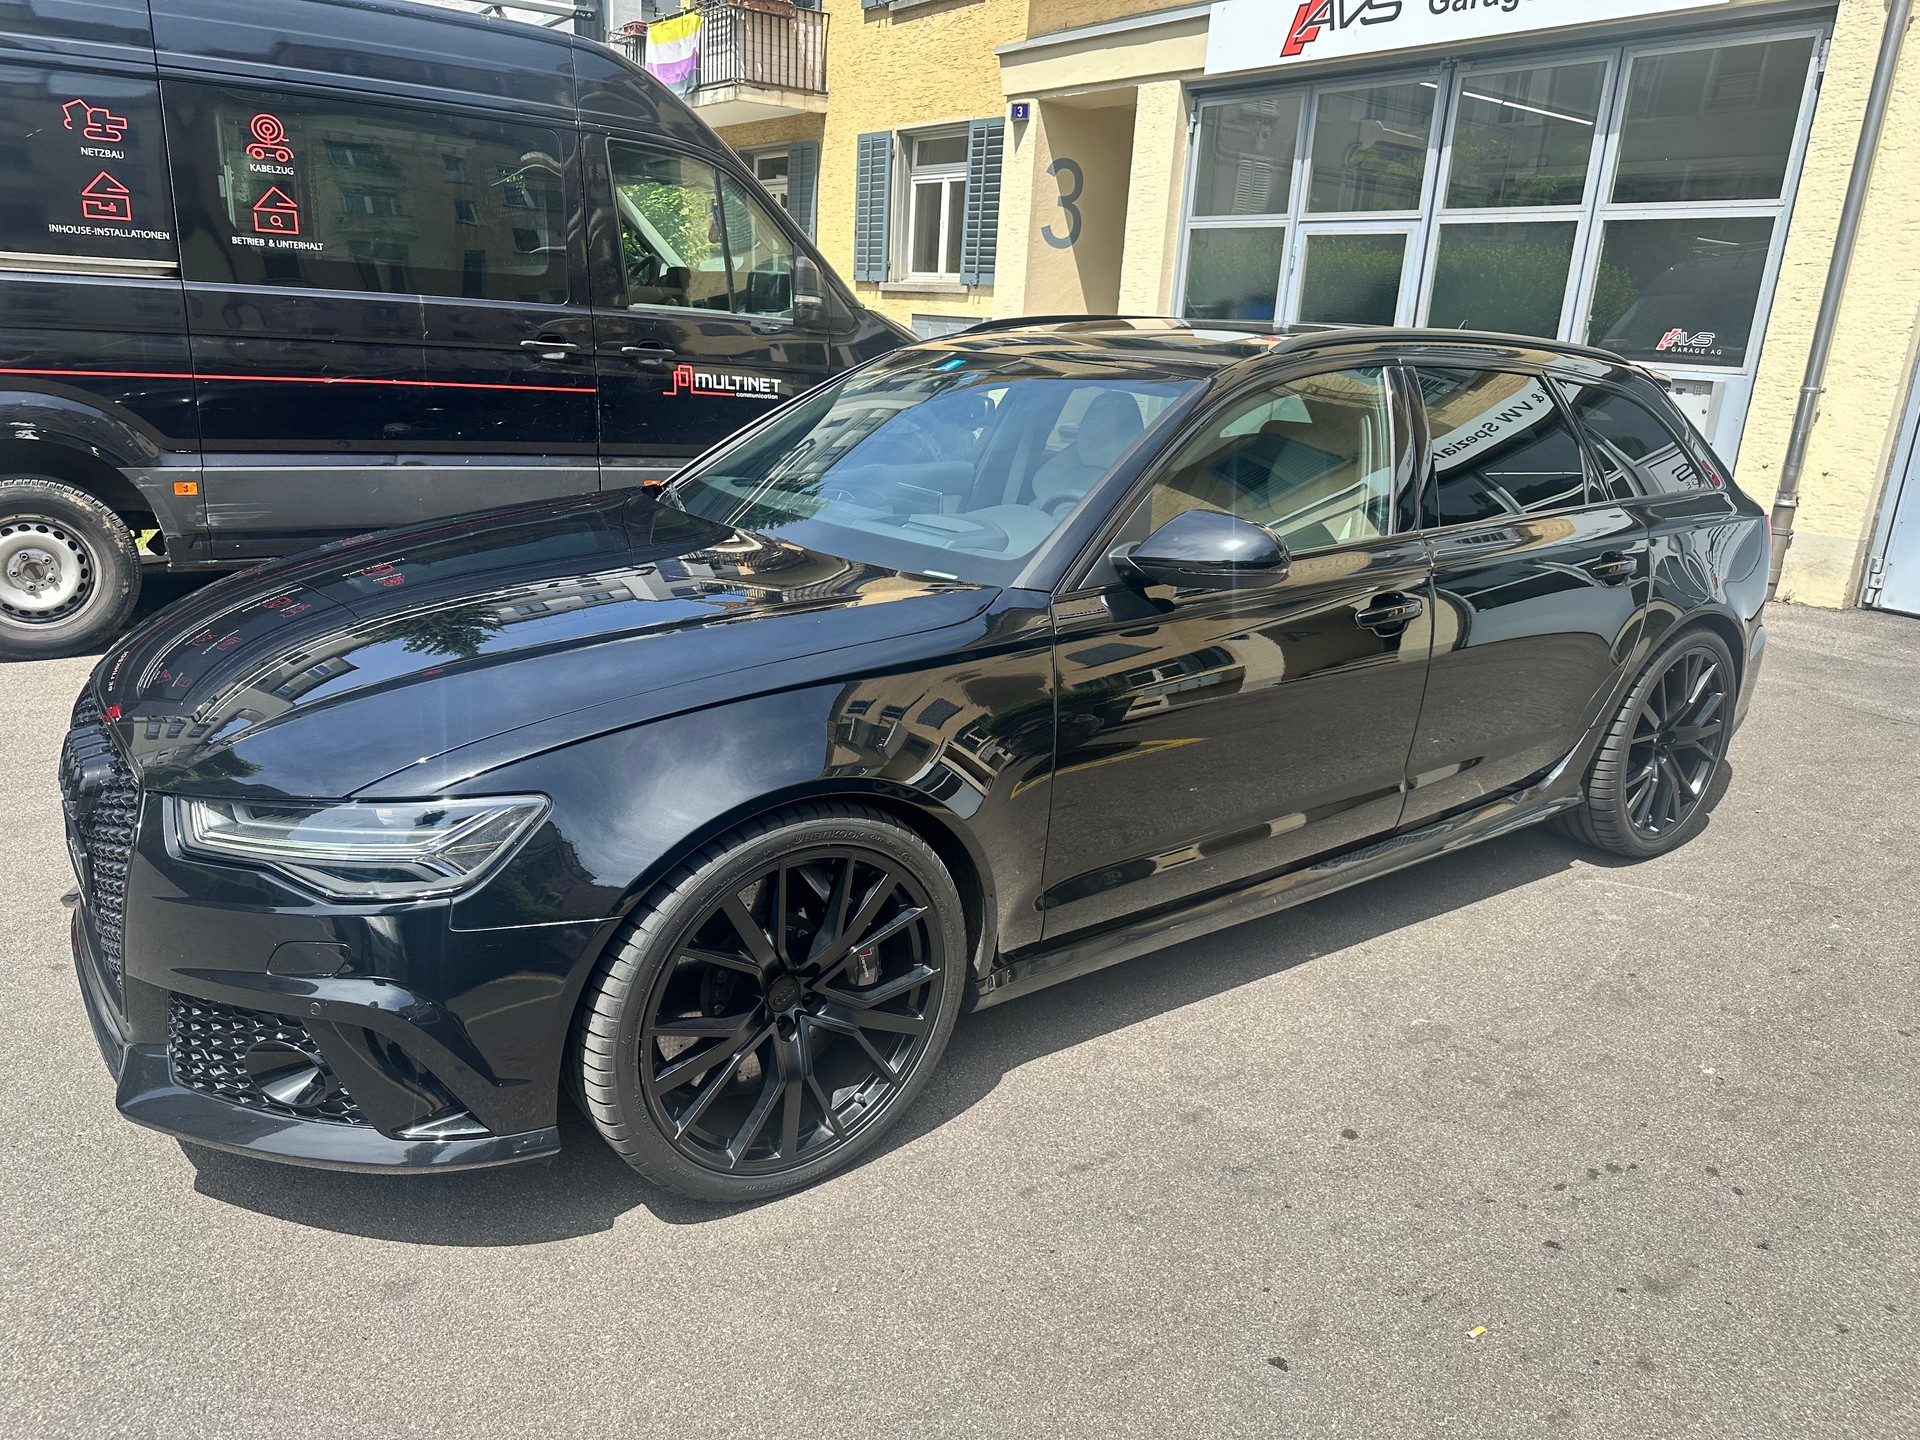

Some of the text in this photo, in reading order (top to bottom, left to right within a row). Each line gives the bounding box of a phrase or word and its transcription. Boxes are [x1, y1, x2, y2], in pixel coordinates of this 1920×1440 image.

[1295, 0, 1532, 35] AVS Garg
[1017, 106, 1023, 118] 3
[80, 146, 125, 160] NETZBAU
[249, 163, 295, 176] KABELZUG
[1041, 157, 1084, 249] 3
[48, 223, 170, 240] INHOUSE-INSTALLATIONEN
[231, 235, 324, 251] BETRIEB & UNTERHALT
[1665, 331, 1716, 348] AVS
[1672, 346, 1706, 355] GARAGE
[694, 373, 782, 393] MULTINET
[735, 391, 779, 400] communication
